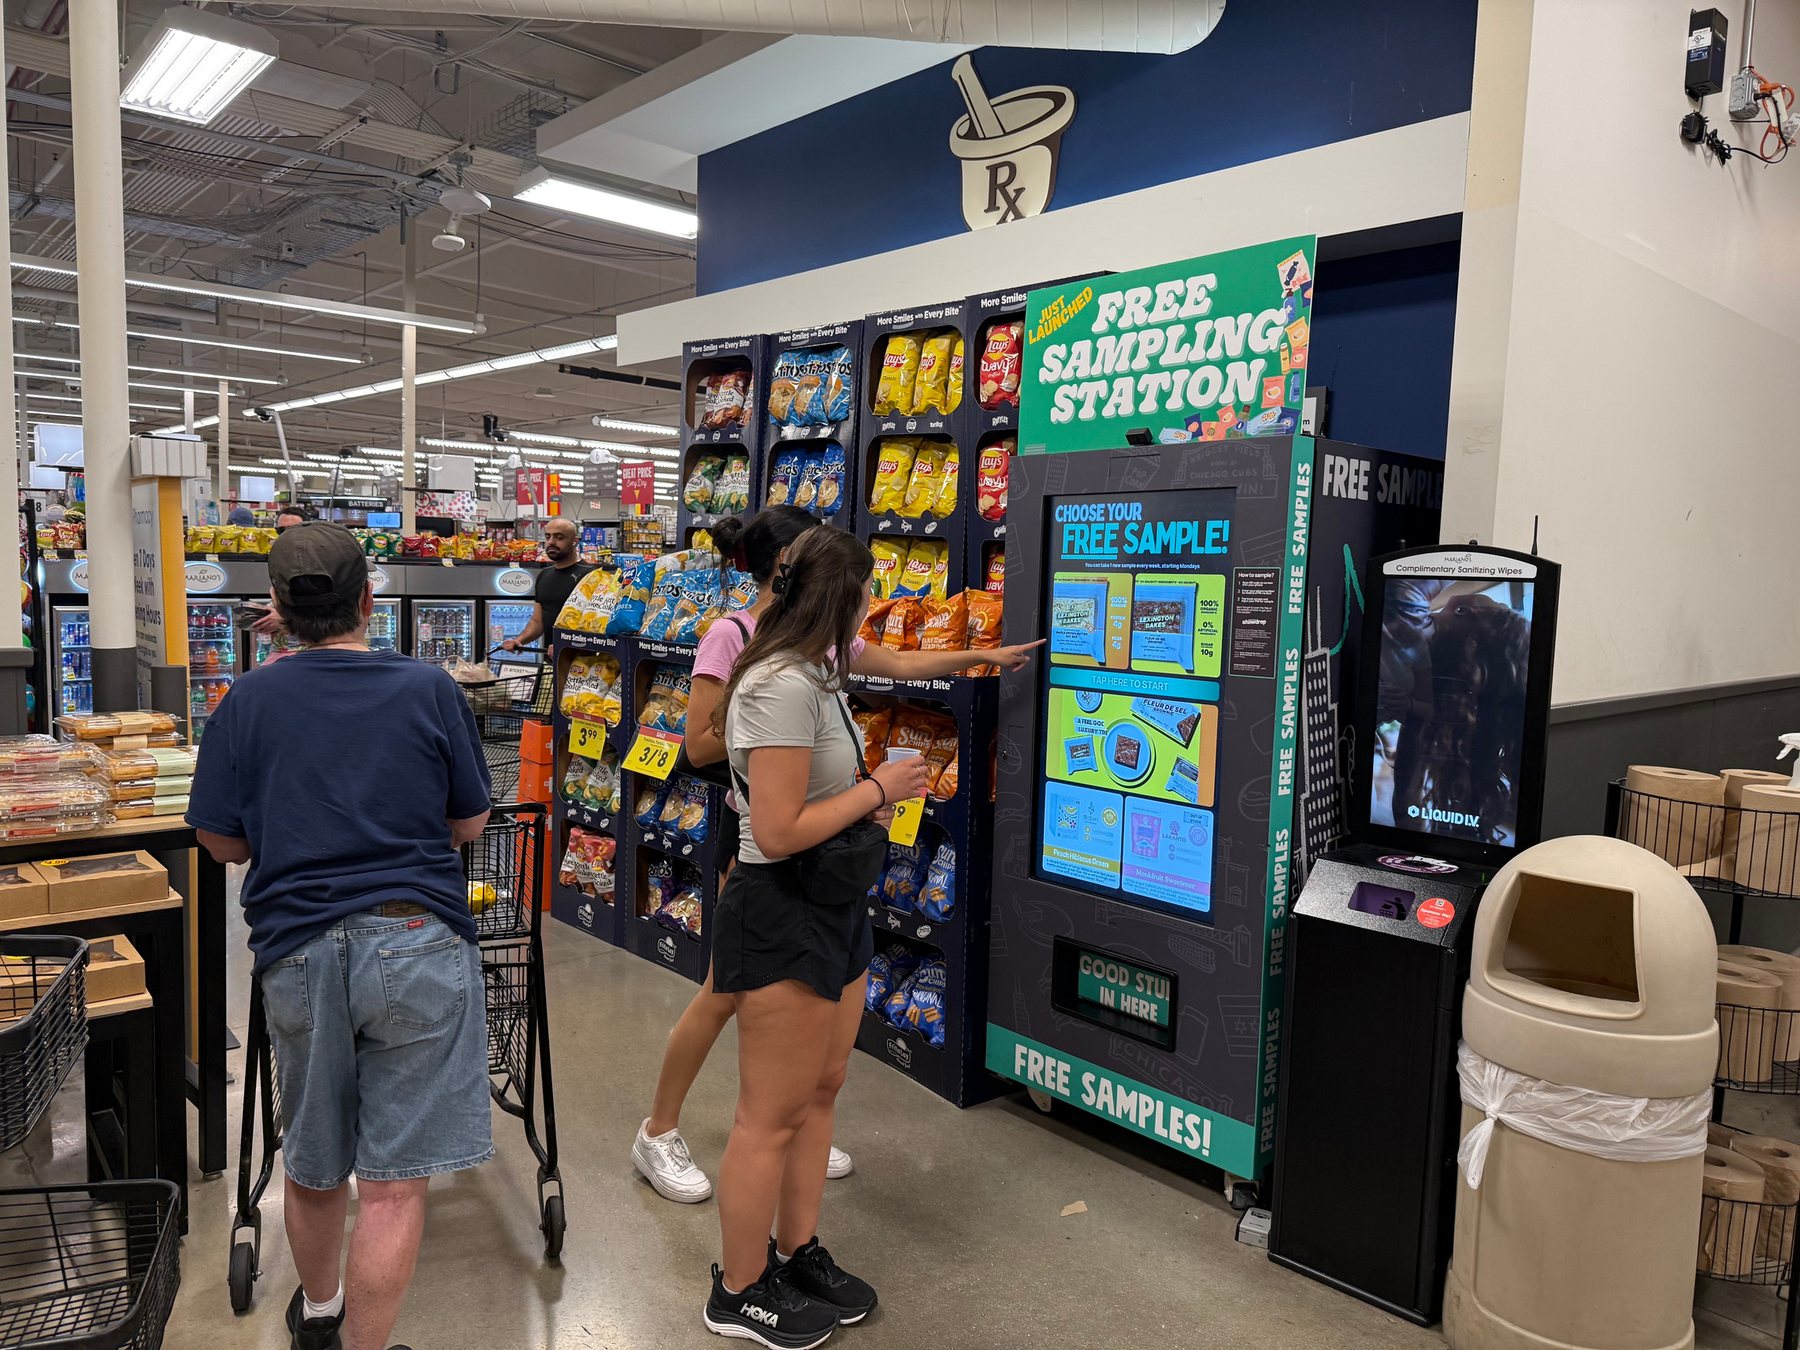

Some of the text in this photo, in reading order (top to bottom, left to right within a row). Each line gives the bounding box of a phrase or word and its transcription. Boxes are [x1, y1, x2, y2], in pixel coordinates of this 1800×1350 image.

[981, 292, 1027, 308] More Smiles
[1039, 295, 1065, 324] JUST
[1091, 273, 1217, 333] FREE
[877, 316, 893, 326] More
[893, 313, 914, 324] Smiles
[924, 308, 944, 320] Every
[1029, 286, 1093, 345] LAUNCHED
[779, 335, 792, 344] More
[792, 333, 810, 342] Smiles
[817, 329, 835, 338] Every
[1039, 307, 1288, 384] SAMPLING
[1050, 358, 1267, 424] STATION
[1322, 454, 1443, 509] FREE SAMPLE
[35, 501, 42, 513] 8
[1055, 502, 1143, 522] CHOOSE YOUR
[1062, 520, 1230, 555] FREE SAMPLE!
[1289, 463, 1311, 614] FREE SAMPLES
[1396, 564, 1522, 575] Complimentary Sanitizing Wipes
[1200, 600, 1219, 608] 100%
[1139, 614, 1175, 623] LEXINGTON
[561, 632, 571, 641] More
[571, 634, 587, 644] Smiles
[593, 638, 606, 648] Every
[639, 641, 651, 650] More
[651, 642, 668, 653] Smiles
[675, 647, 692, 656] Every
[1200, 649, 1213, 657] 10g
[907, 680, 931, 690] Every
[1092, 675, 1169, 691] TAP HERE TO START
[1174, 704, 1187, 715] SEL
[1278, 648, 1298, 796] FREE SAMPLES
[897, 726, 932, 746] Sun
[1421, 808, 1464, 825] LIQUID
[1053, 848, 1069, 859] Peach
[1092, 858, 1109, 869] Green
[1136, 869, 1195, 889] Monkfruit Sweetener
[1270, 828, 1288, 976] FREE SAMPLES
[1079, 955, 1170, 1001] GOOD STU
[1099, 986, 1158, 1023] IN HERE
[1260, 1008, 1280, 1154] FREE SAMPLES
[1014, 1043, 1211, 1157] FREE SAMPLES!
[739, 1302, 779, 1328] HOKA
